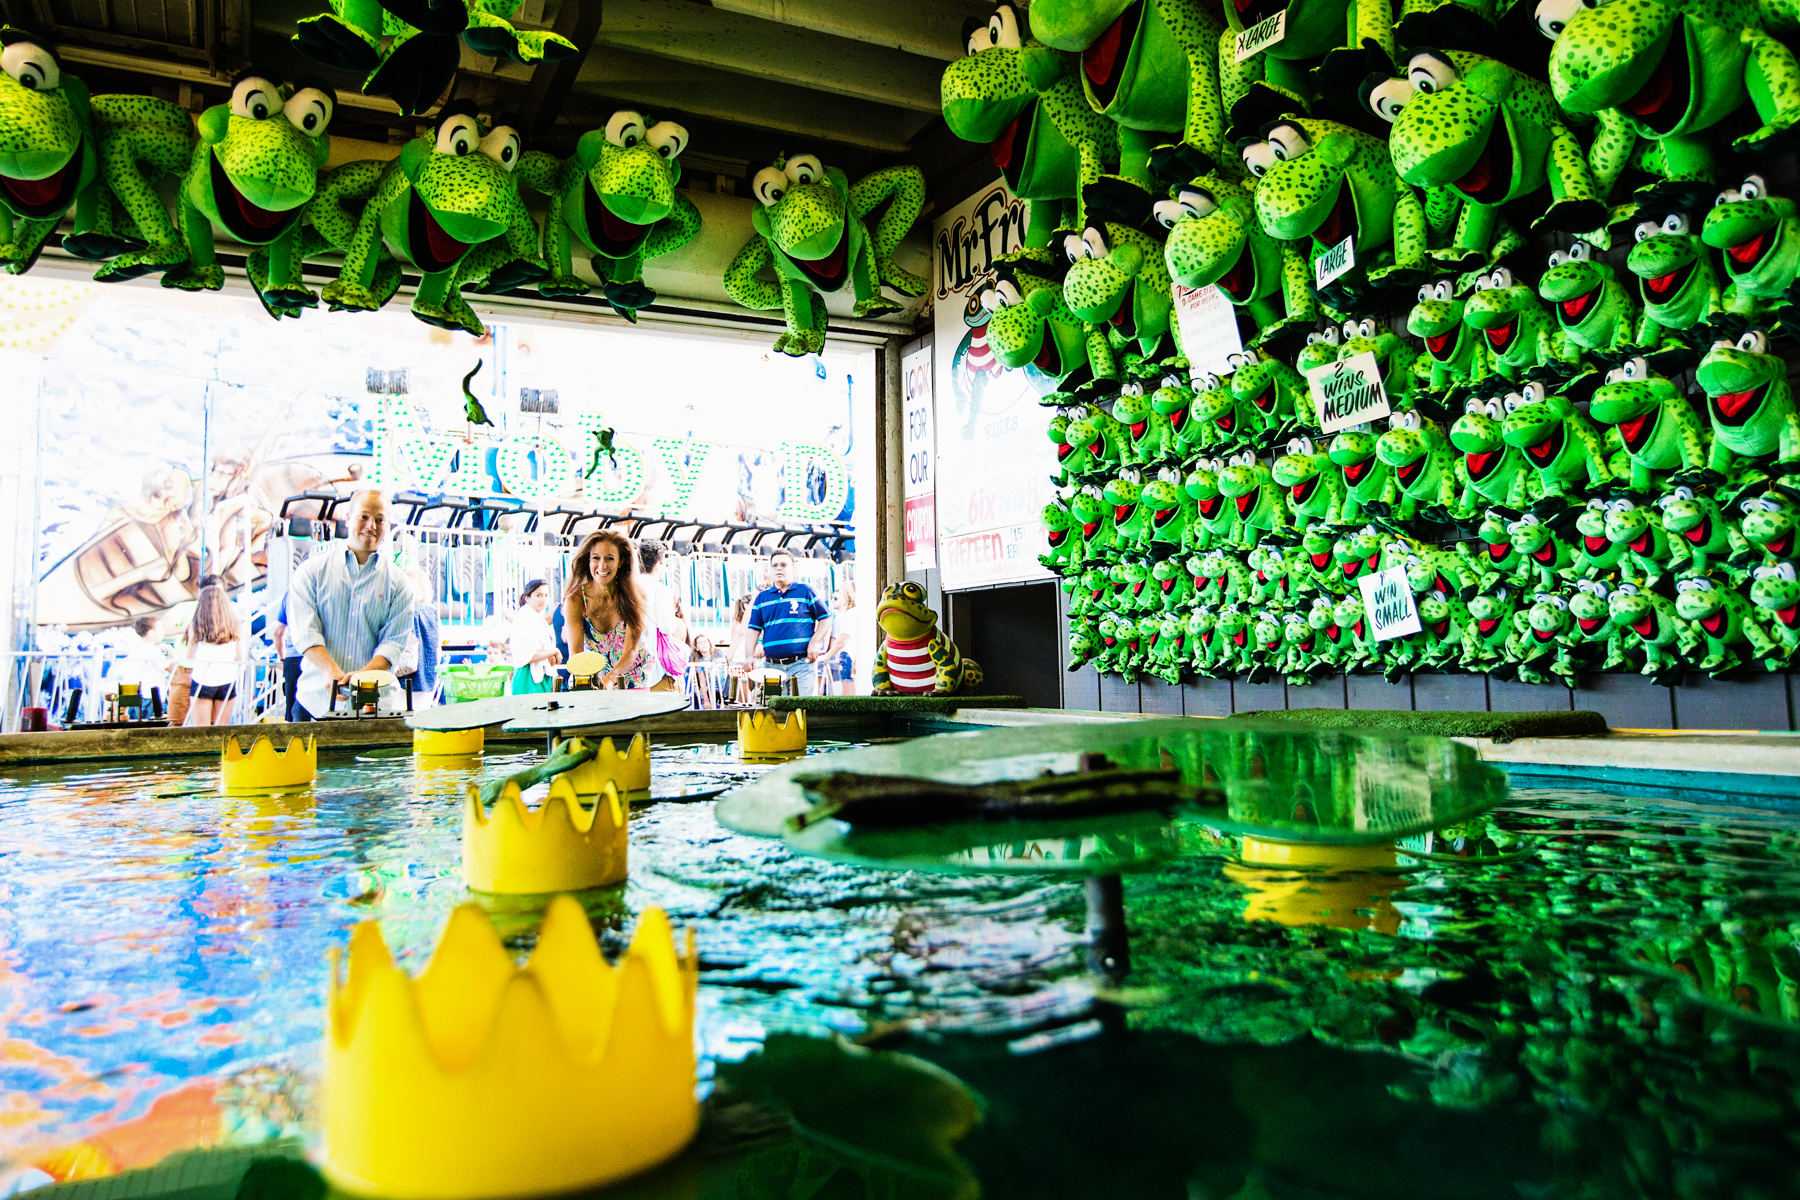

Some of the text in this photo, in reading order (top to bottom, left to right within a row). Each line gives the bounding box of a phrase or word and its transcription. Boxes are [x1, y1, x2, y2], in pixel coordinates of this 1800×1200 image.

[1237, 12, 1283, 55] X-LARGE
[1319, 239, 1348, 281] LARGE
[1187, 290, 1203, 303] SAME
[1190, 300, 1201, 310] FOR
[906, 362, 930, 401] LOOK
[1324, 370, 1364, 399] WINS
[1334, 362, 1344, 379] 2
[1323, 382, 1383, 423] MEDIUM
[910, 407, 927, 442] FOR
[984, 414, 1018, 440] RULES
[910, 450, 929, 485] OUR
[906, 505, 934, 542] COUPON
[1010, 526, 1025, 542] (15)
[1006, 539, 1034, 559] FROGS
[1374, 581, 1397, 605] WIN
[1375, 596, 1412, 630] SMALL
